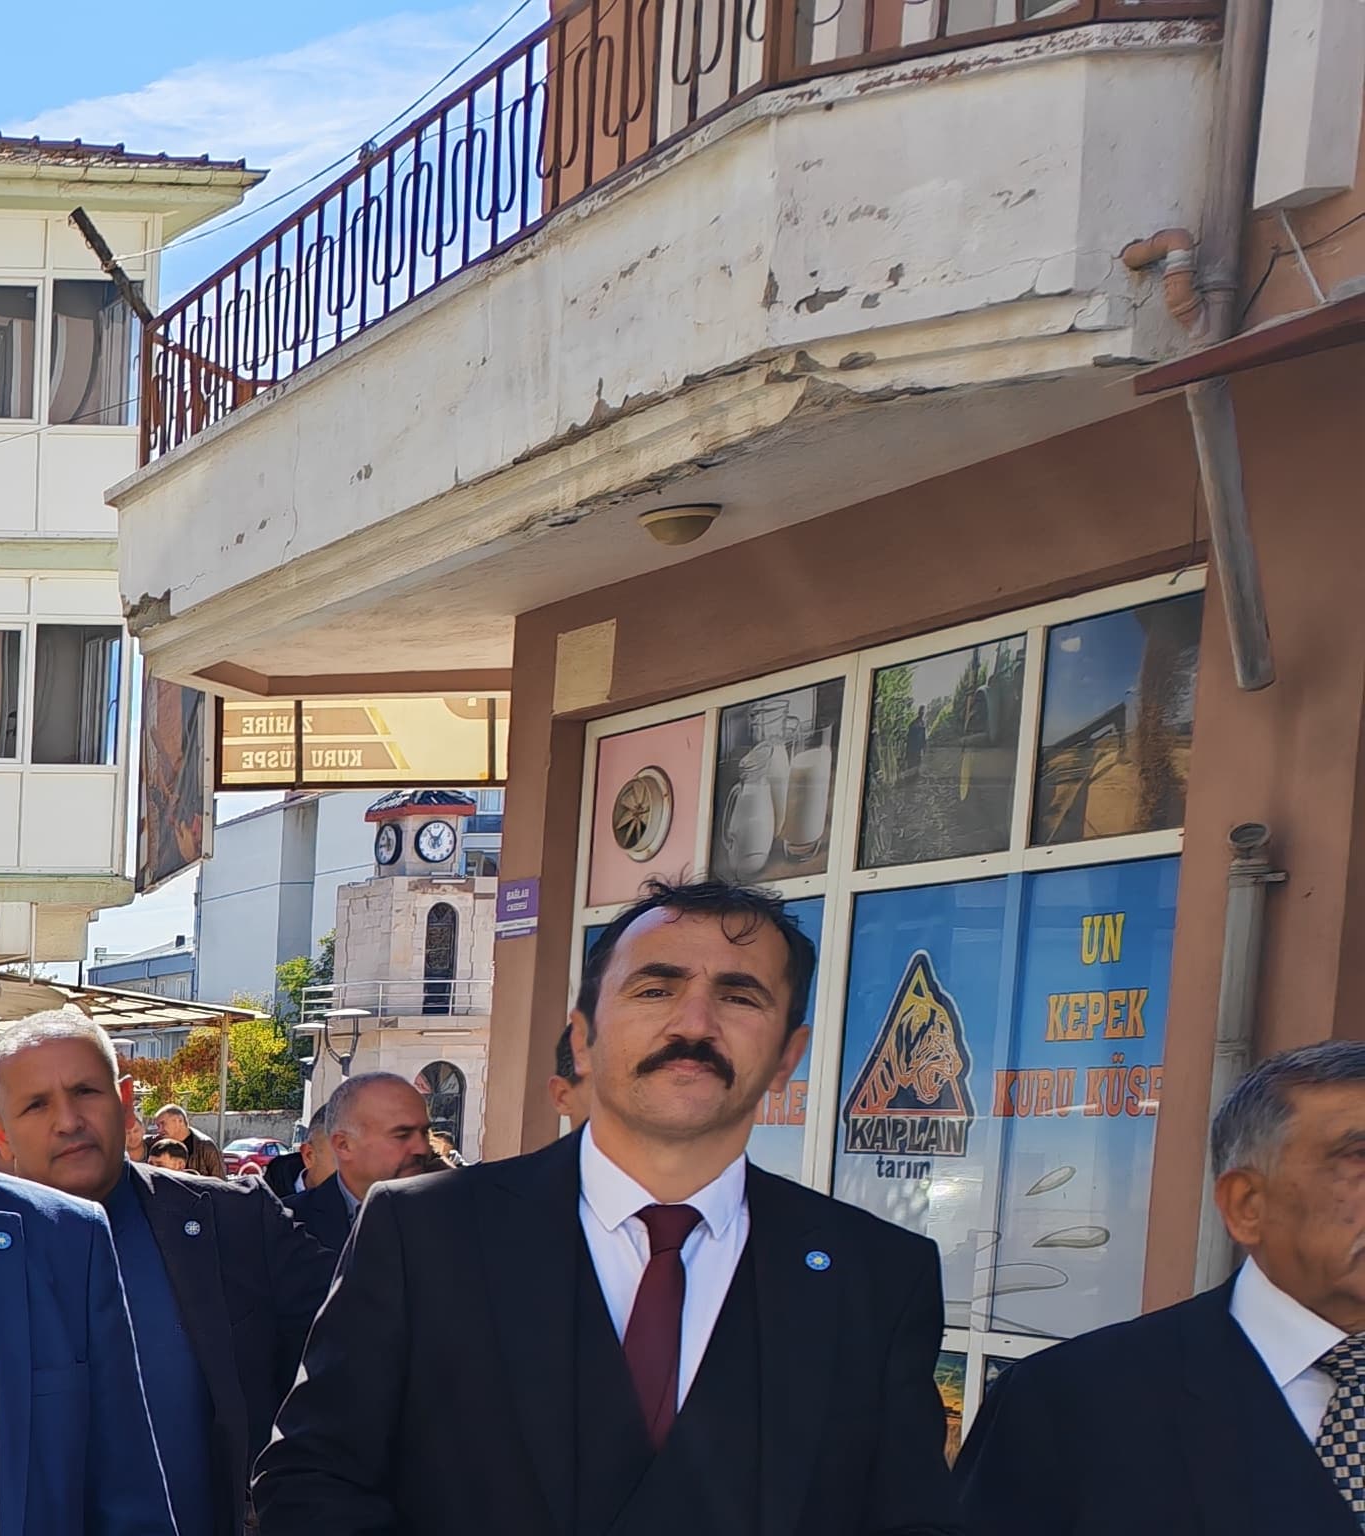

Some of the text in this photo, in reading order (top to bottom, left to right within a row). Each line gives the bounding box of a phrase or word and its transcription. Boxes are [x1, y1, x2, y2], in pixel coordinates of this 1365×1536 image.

[1080, 912, 1126, 965] UN
[1044, 988, 1149, 1042] KEPEK
[992, 1066, 1078, 1118] KURU
[846, 1116, 967, 1155] KAPLAN
[876, 1155, 931, 1179] tarım
